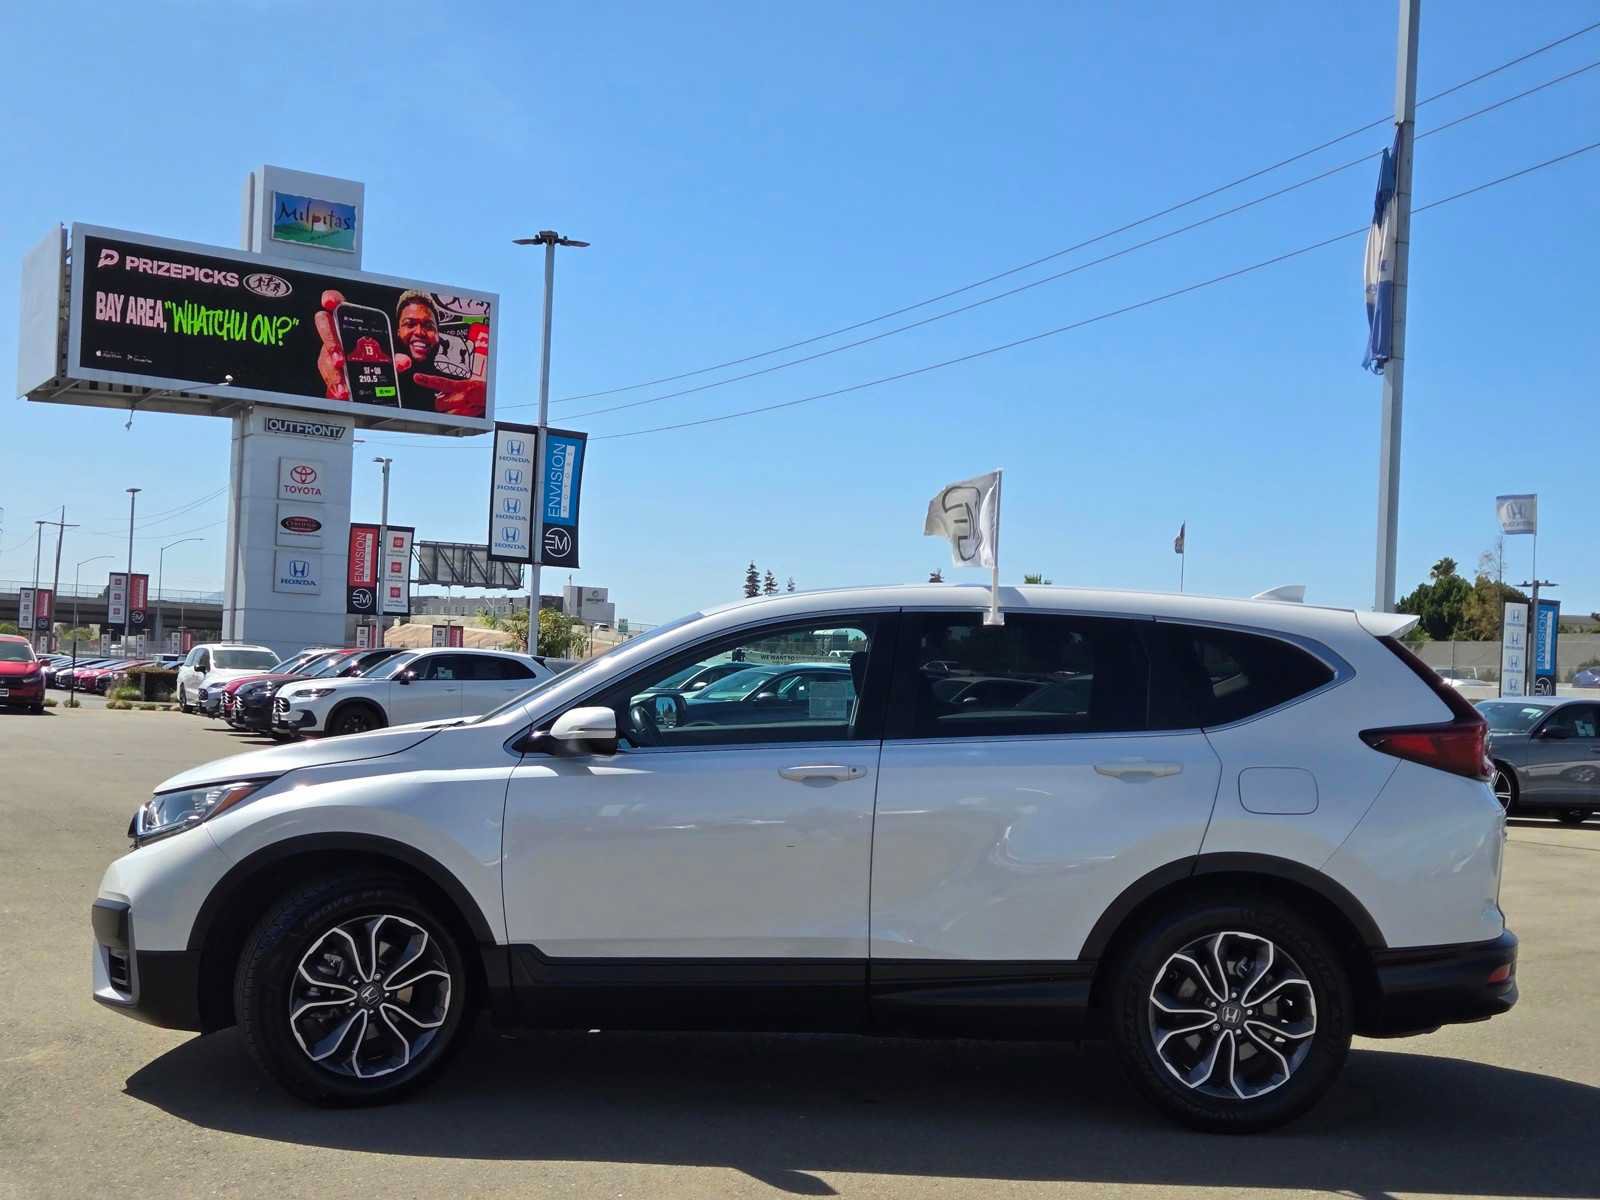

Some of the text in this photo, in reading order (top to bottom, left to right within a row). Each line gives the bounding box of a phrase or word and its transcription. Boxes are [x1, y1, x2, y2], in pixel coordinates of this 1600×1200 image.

[279, 200, 351, 231] Milpitas
[125, 255, 240, 288] PRIZEPICKS
[95, 291, 125, 321] BAY
[126, 295, 168, 333] AREA,
[499, 455, 530, 464] HONDA
[547, 443, 566, 517] ENVISION
[283, 485, 322, 496] TOYOTA
[496, 484, 529, 493] HONDA
[495, 513, 528, 521] HONDA
[494, 542, 527, 550] HONDA
[353, 531, 367, 582] ENVISION
[280, 578, 317, 586] HONDA
